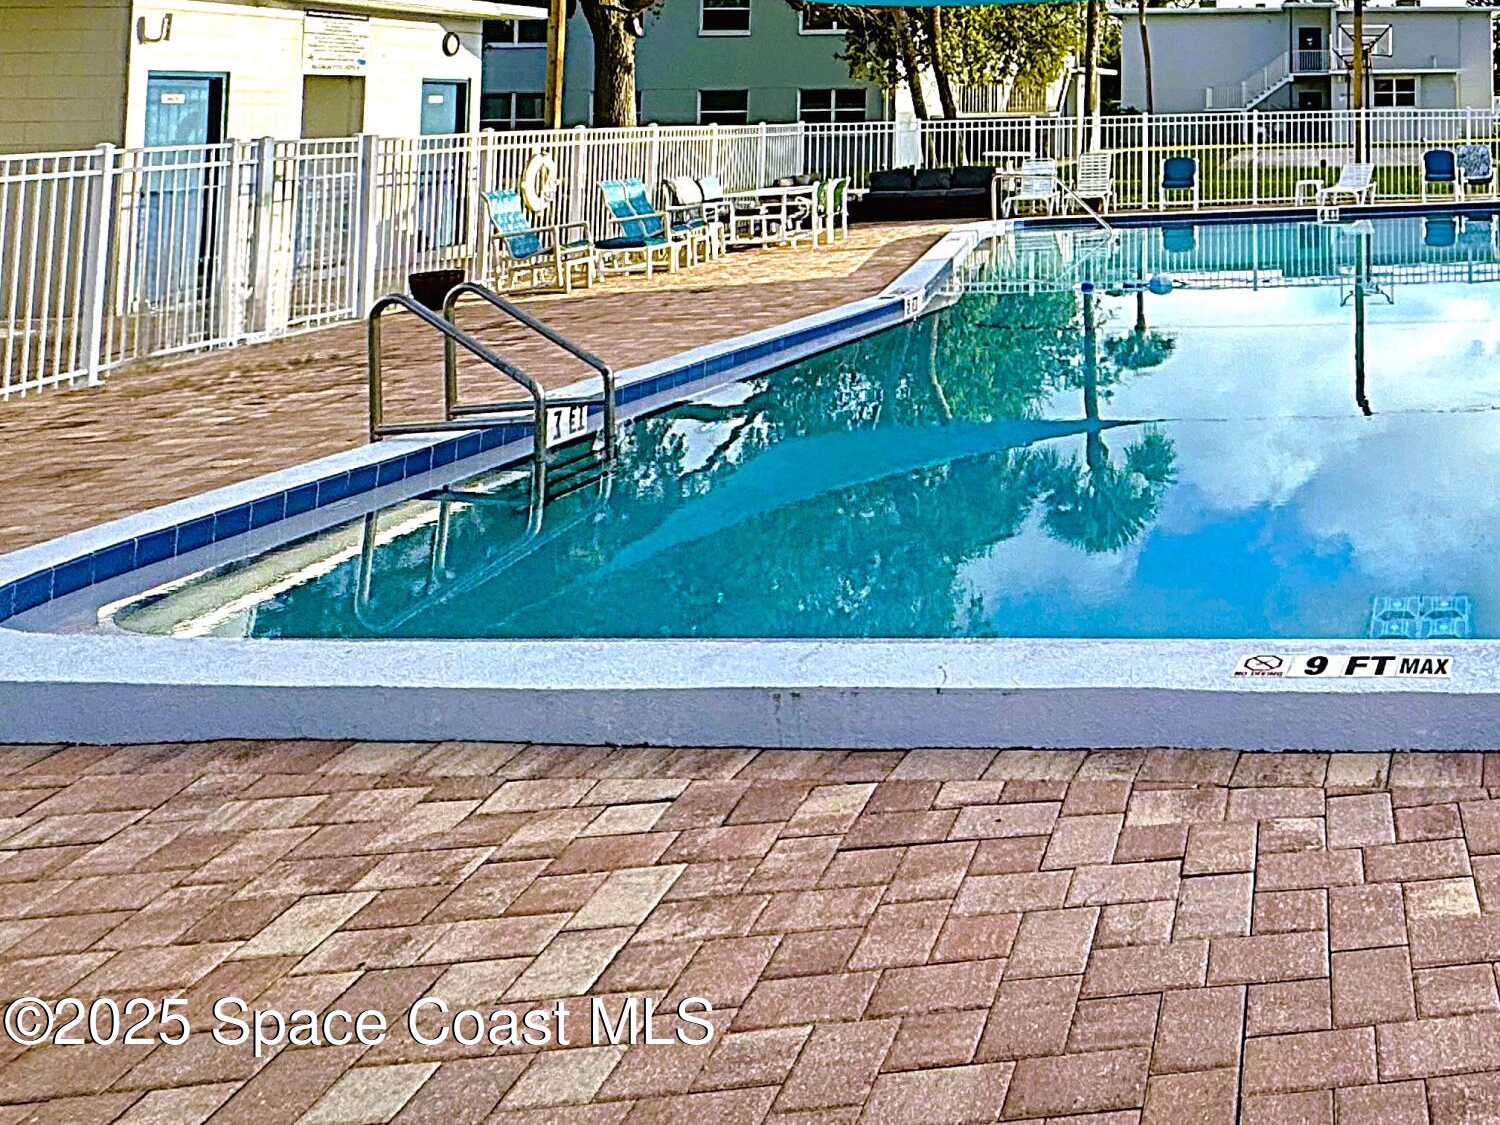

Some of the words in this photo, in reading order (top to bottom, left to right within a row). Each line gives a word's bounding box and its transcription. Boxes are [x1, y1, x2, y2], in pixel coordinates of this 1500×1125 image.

[1304, 655, 1329, 676] 9
[1344, 655, 1396, 676] FT
[1399, 657, 1450, 675] MAX
